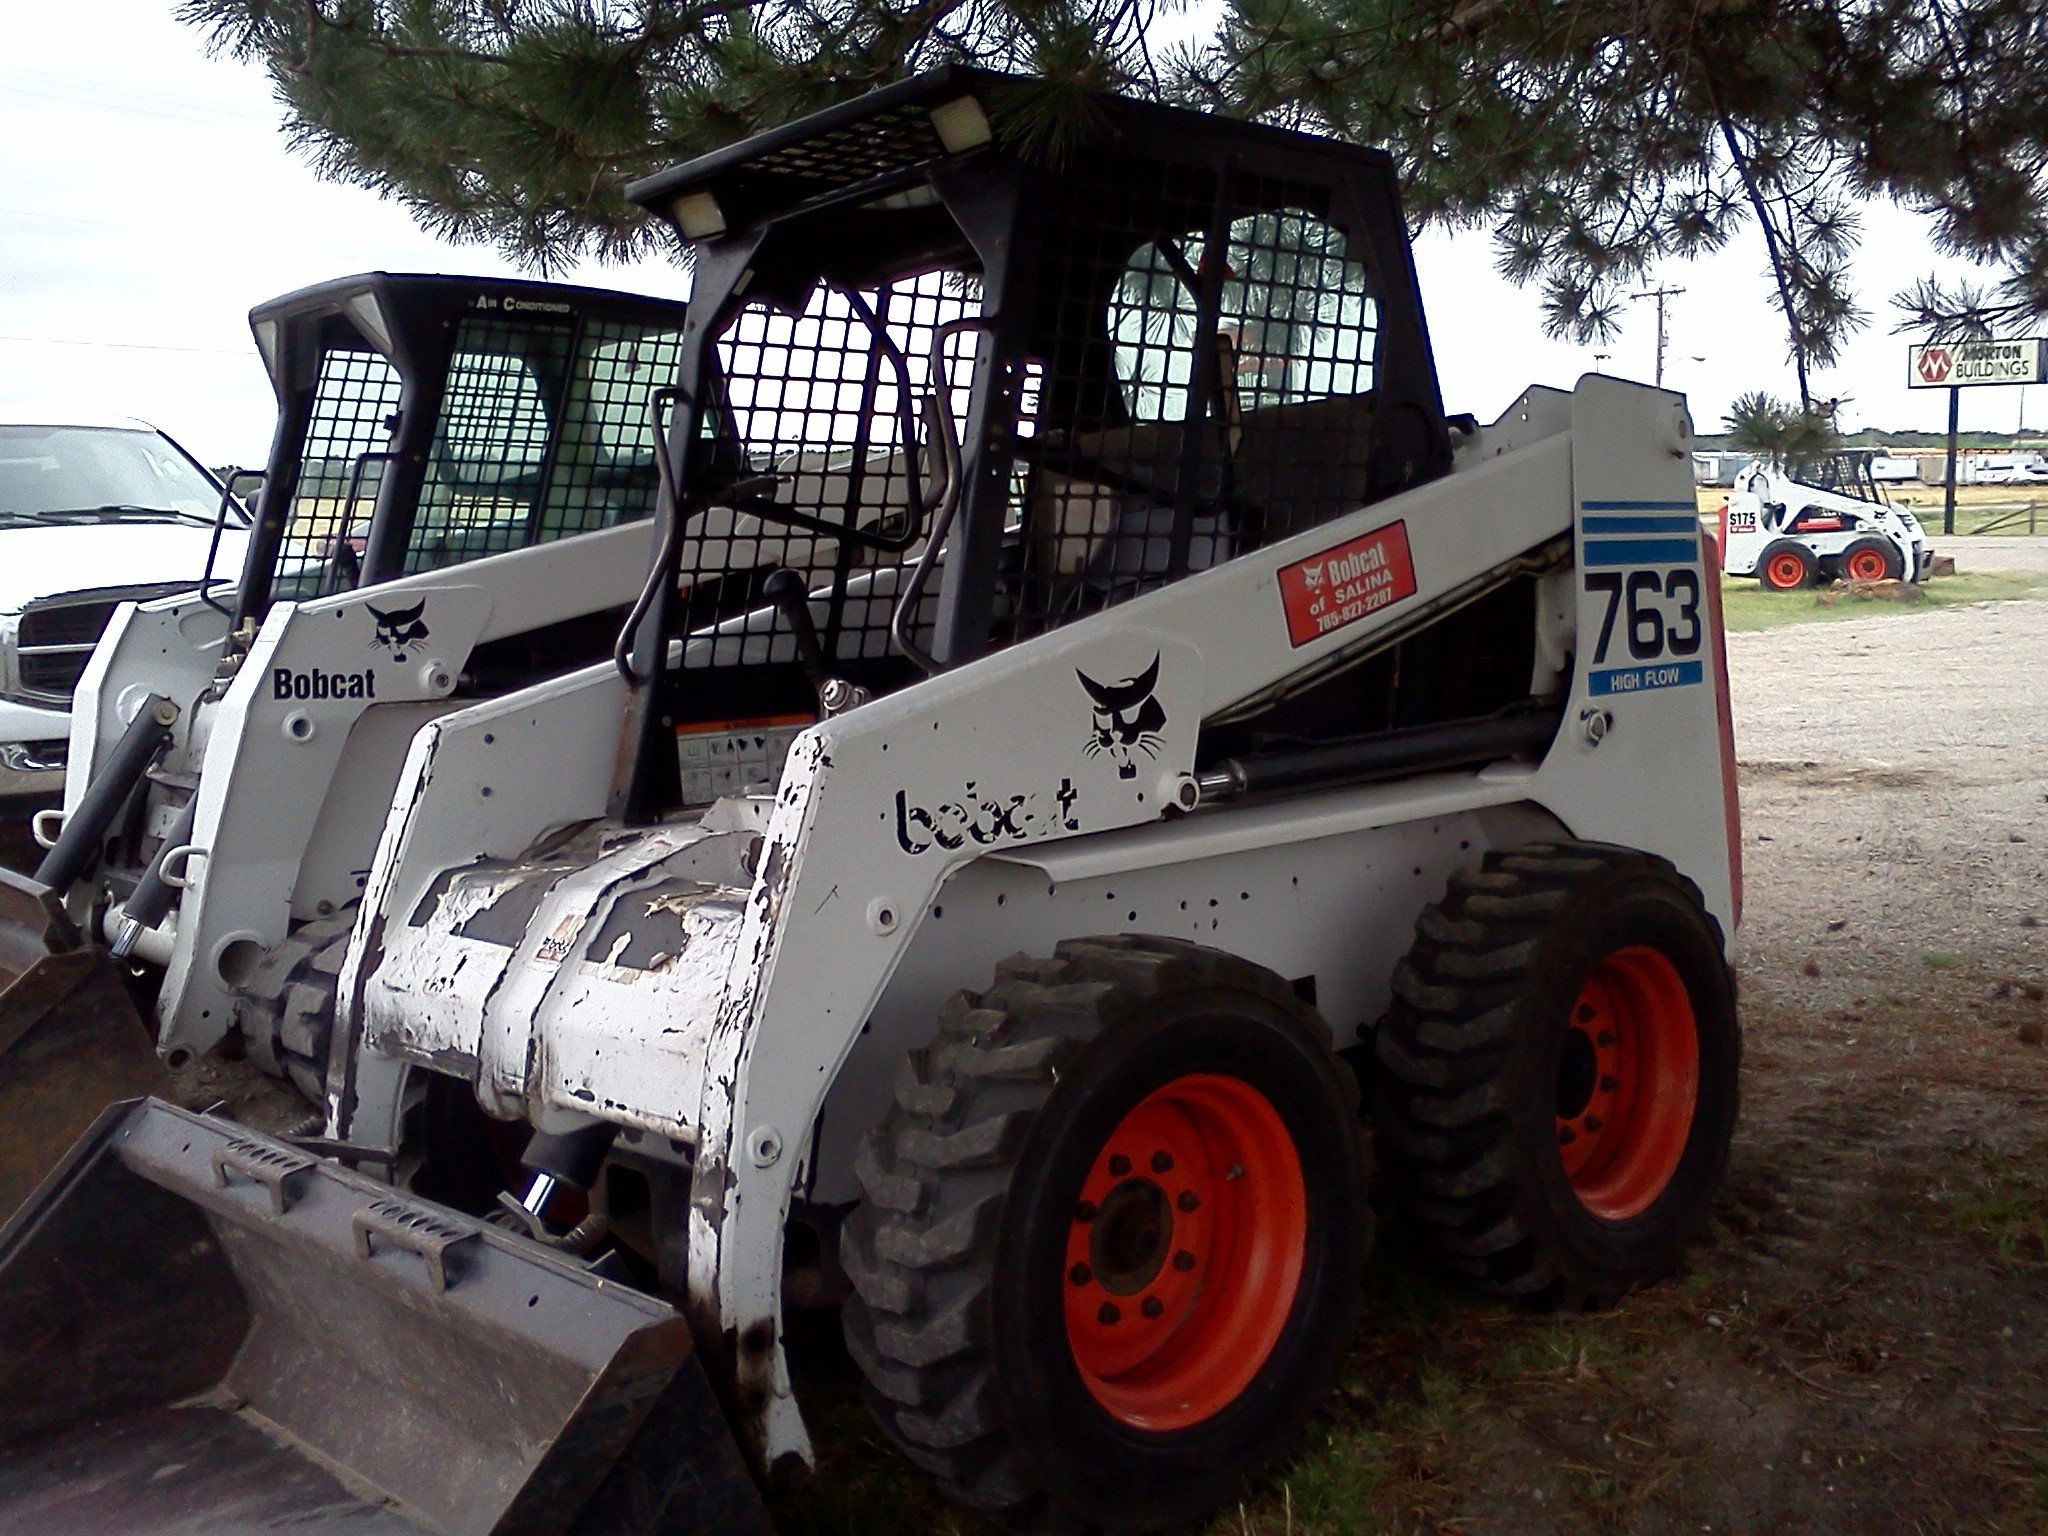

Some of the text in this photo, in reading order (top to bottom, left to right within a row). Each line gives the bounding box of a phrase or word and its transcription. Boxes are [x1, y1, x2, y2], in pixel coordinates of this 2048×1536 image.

[1729, 512, 1756, 526] S175
[1327, 542, 1387, 587] Bobcat
[1310, 569, 1393, 616] of SALINA
[1584, 568, 1700, 665] 763
[274, 668, 375, 700] Bobcat
[1611, 669, 1679, 691] HIGH FLOW
